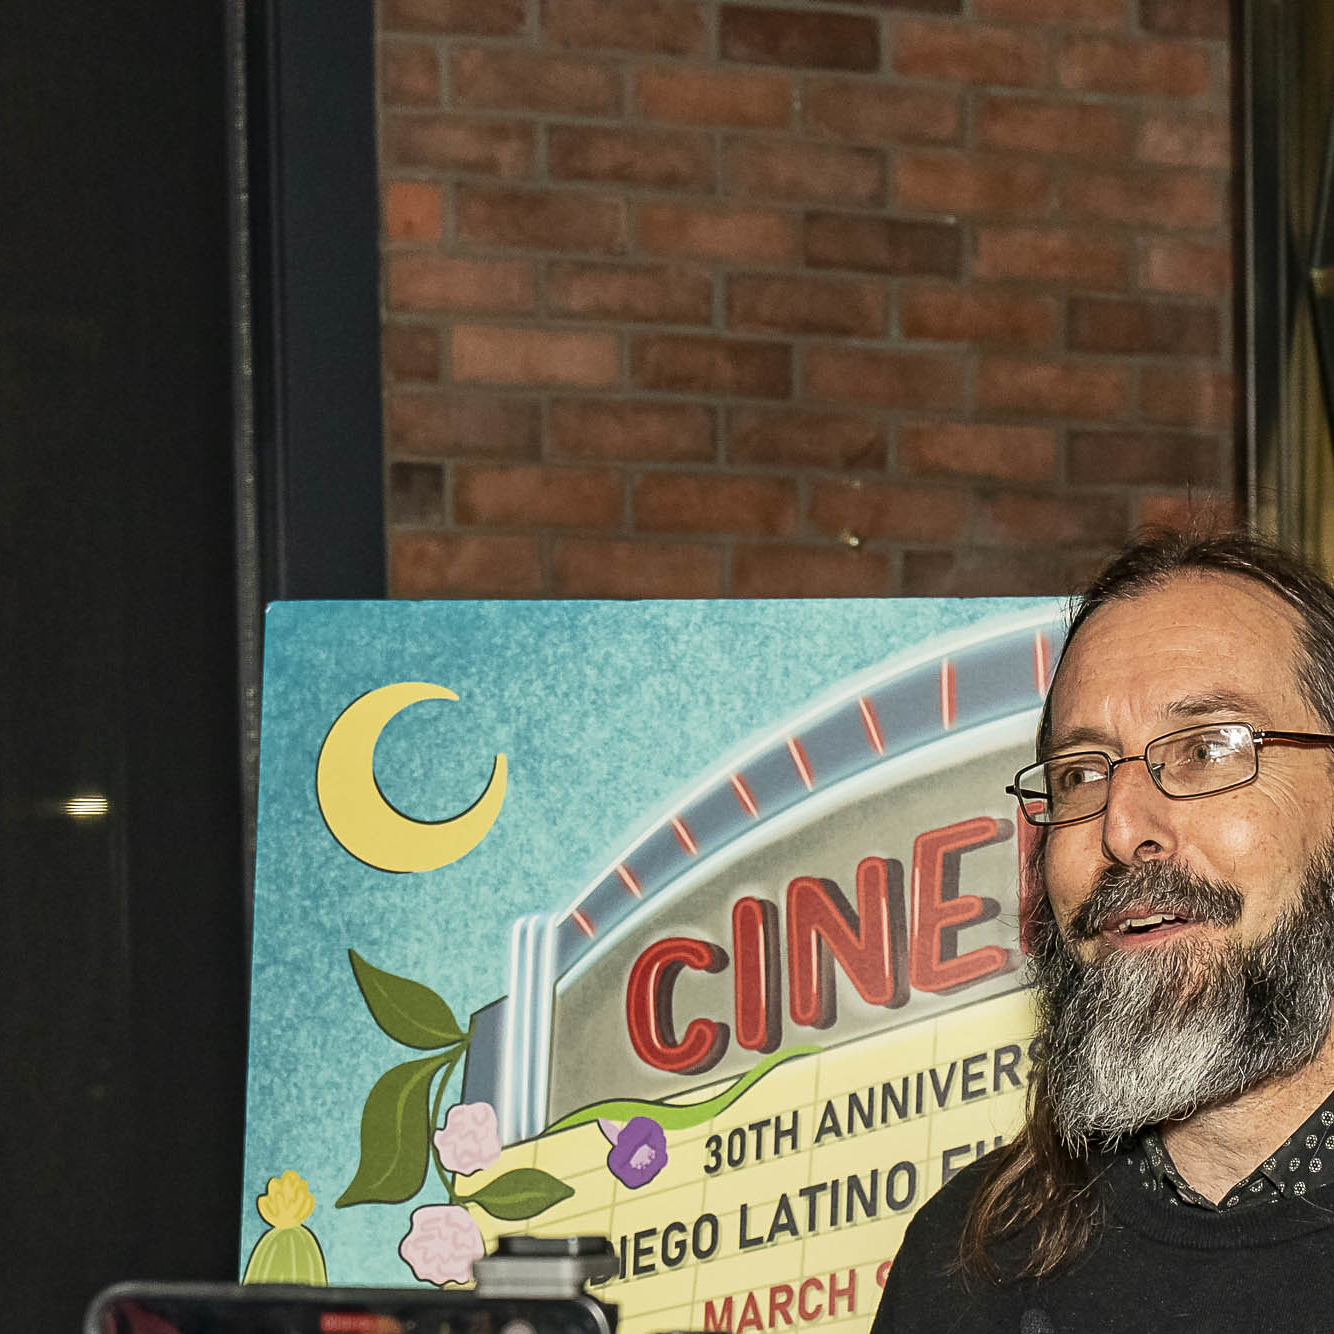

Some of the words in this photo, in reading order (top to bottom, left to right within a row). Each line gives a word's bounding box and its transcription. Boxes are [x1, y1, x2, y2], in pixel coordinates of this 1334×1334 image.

[703, 1110, 799, 1175] 30TH
[589, 1213, 719, 1287] IEGO
[738, 1160, 917, 1251] LATINO
